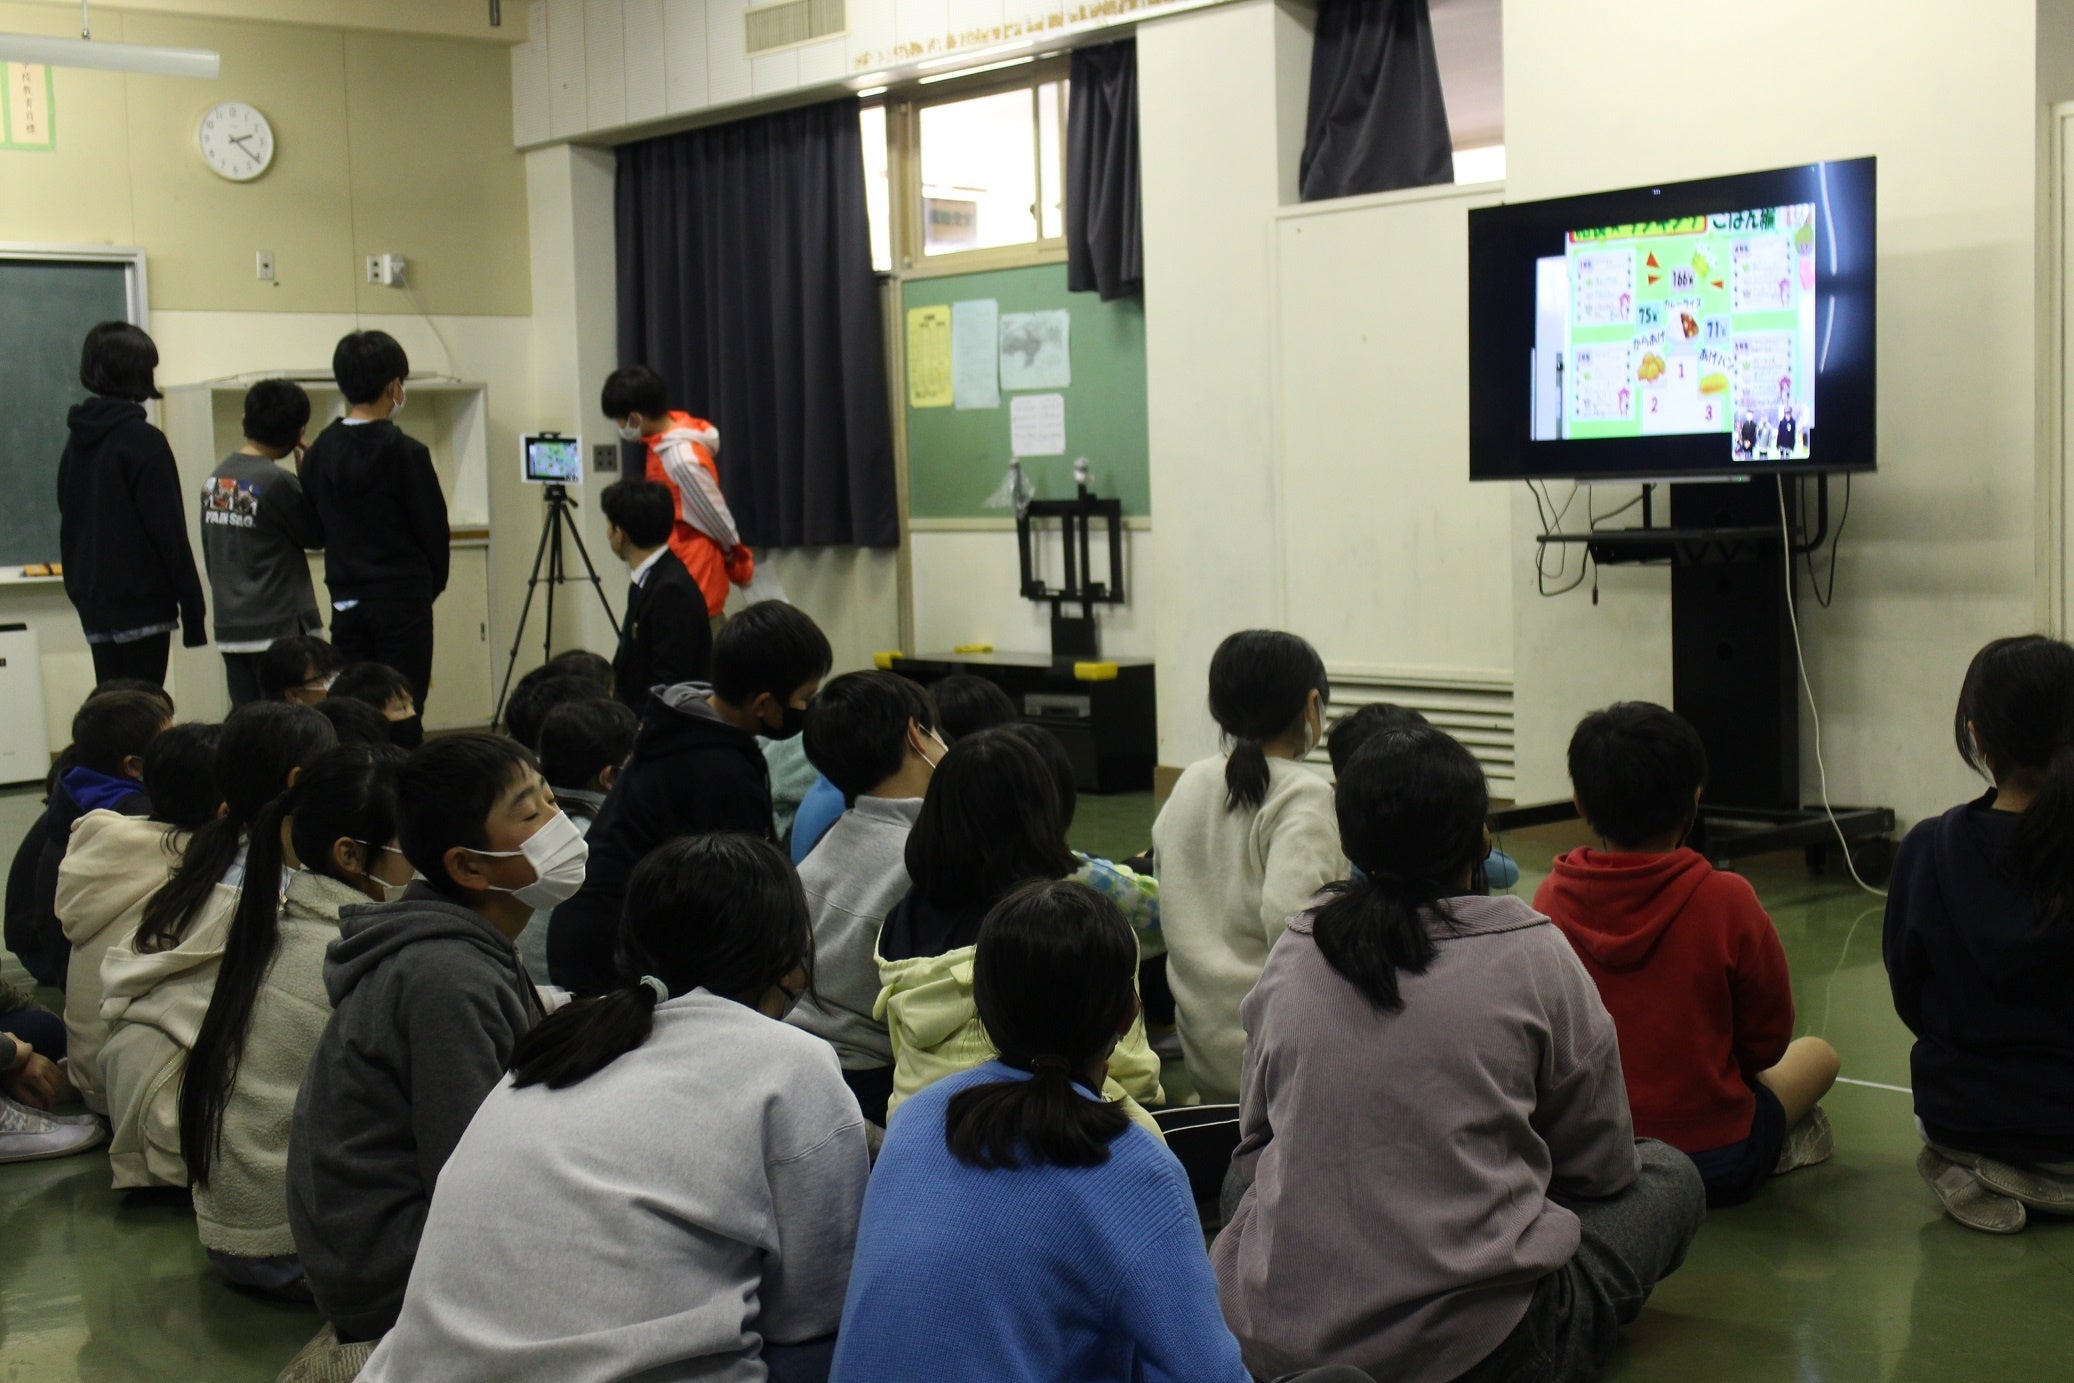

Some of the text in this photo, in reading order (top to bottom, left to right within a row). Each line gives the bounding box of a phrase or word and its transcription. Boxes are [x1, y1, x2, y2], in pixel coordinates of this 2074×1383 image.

[1712, 207, 1775, 231] ごはん編
[1633, 330, 1665, 350] からあげ
[1679, 362, 1684, 378] 1
[1651, 396, 1658, 413] 2
[1705, 404, 1712, 421] 3
